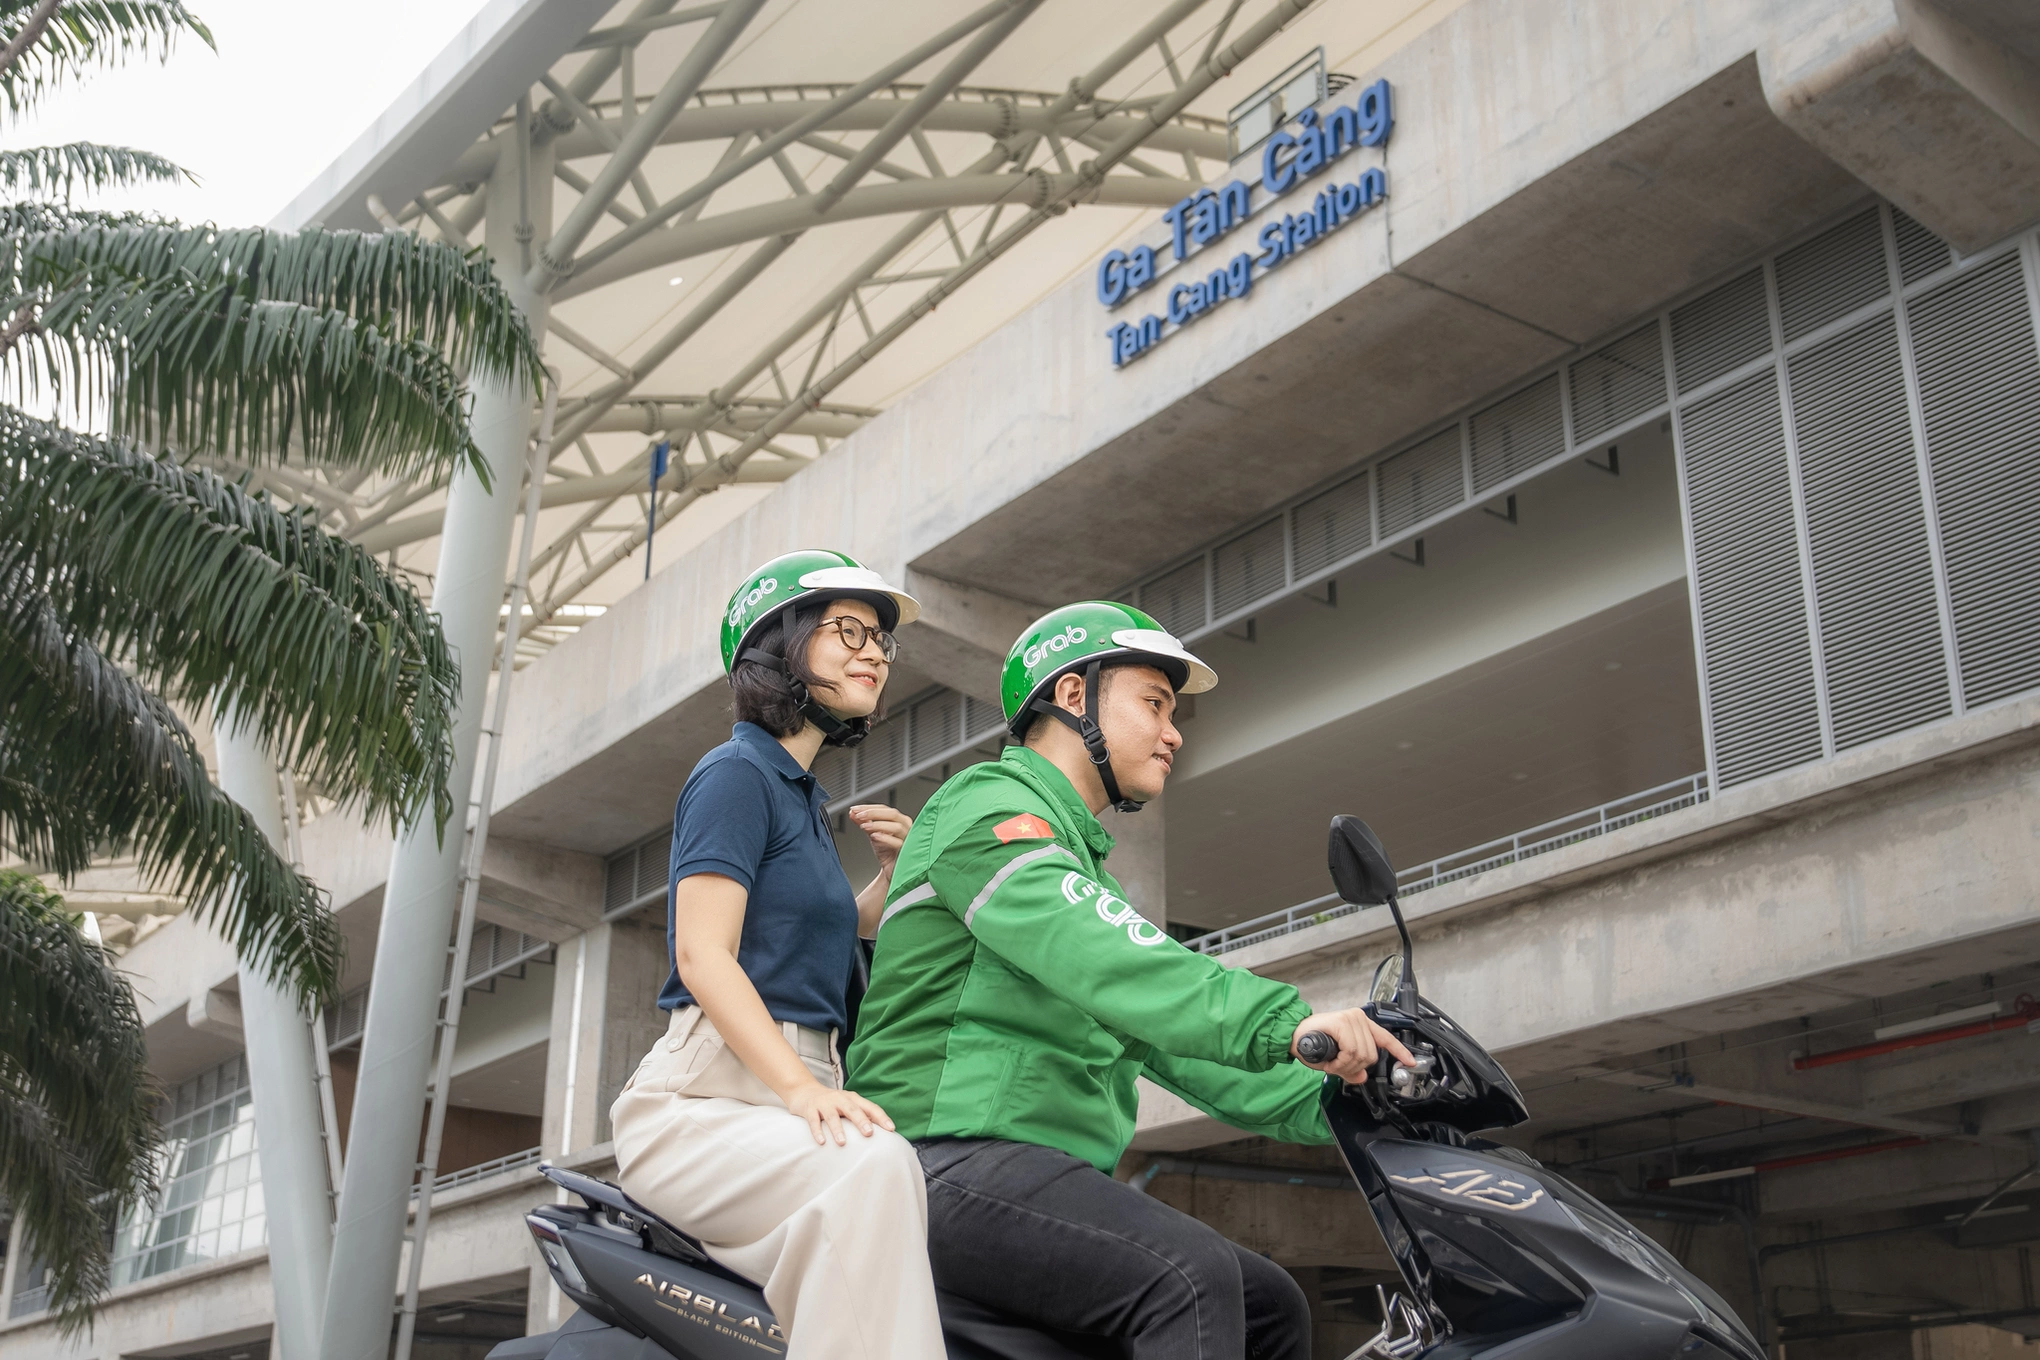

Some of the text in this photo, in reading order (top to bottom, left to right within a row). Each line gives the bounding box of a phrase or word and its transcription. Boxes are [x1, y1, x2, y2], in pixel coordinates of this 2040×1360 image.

[1098, 78, 1394, 307] Ga Tân Cảng
[1106, 166, 1386, 367] Tan Cang Station
[729, 577, 778, 627] Grab
[1023, 625, 1087, 668] Grab
[1061, 871, 1167, 946] Gab
[676, 1307, 758, 1347] BLACK EDITION
